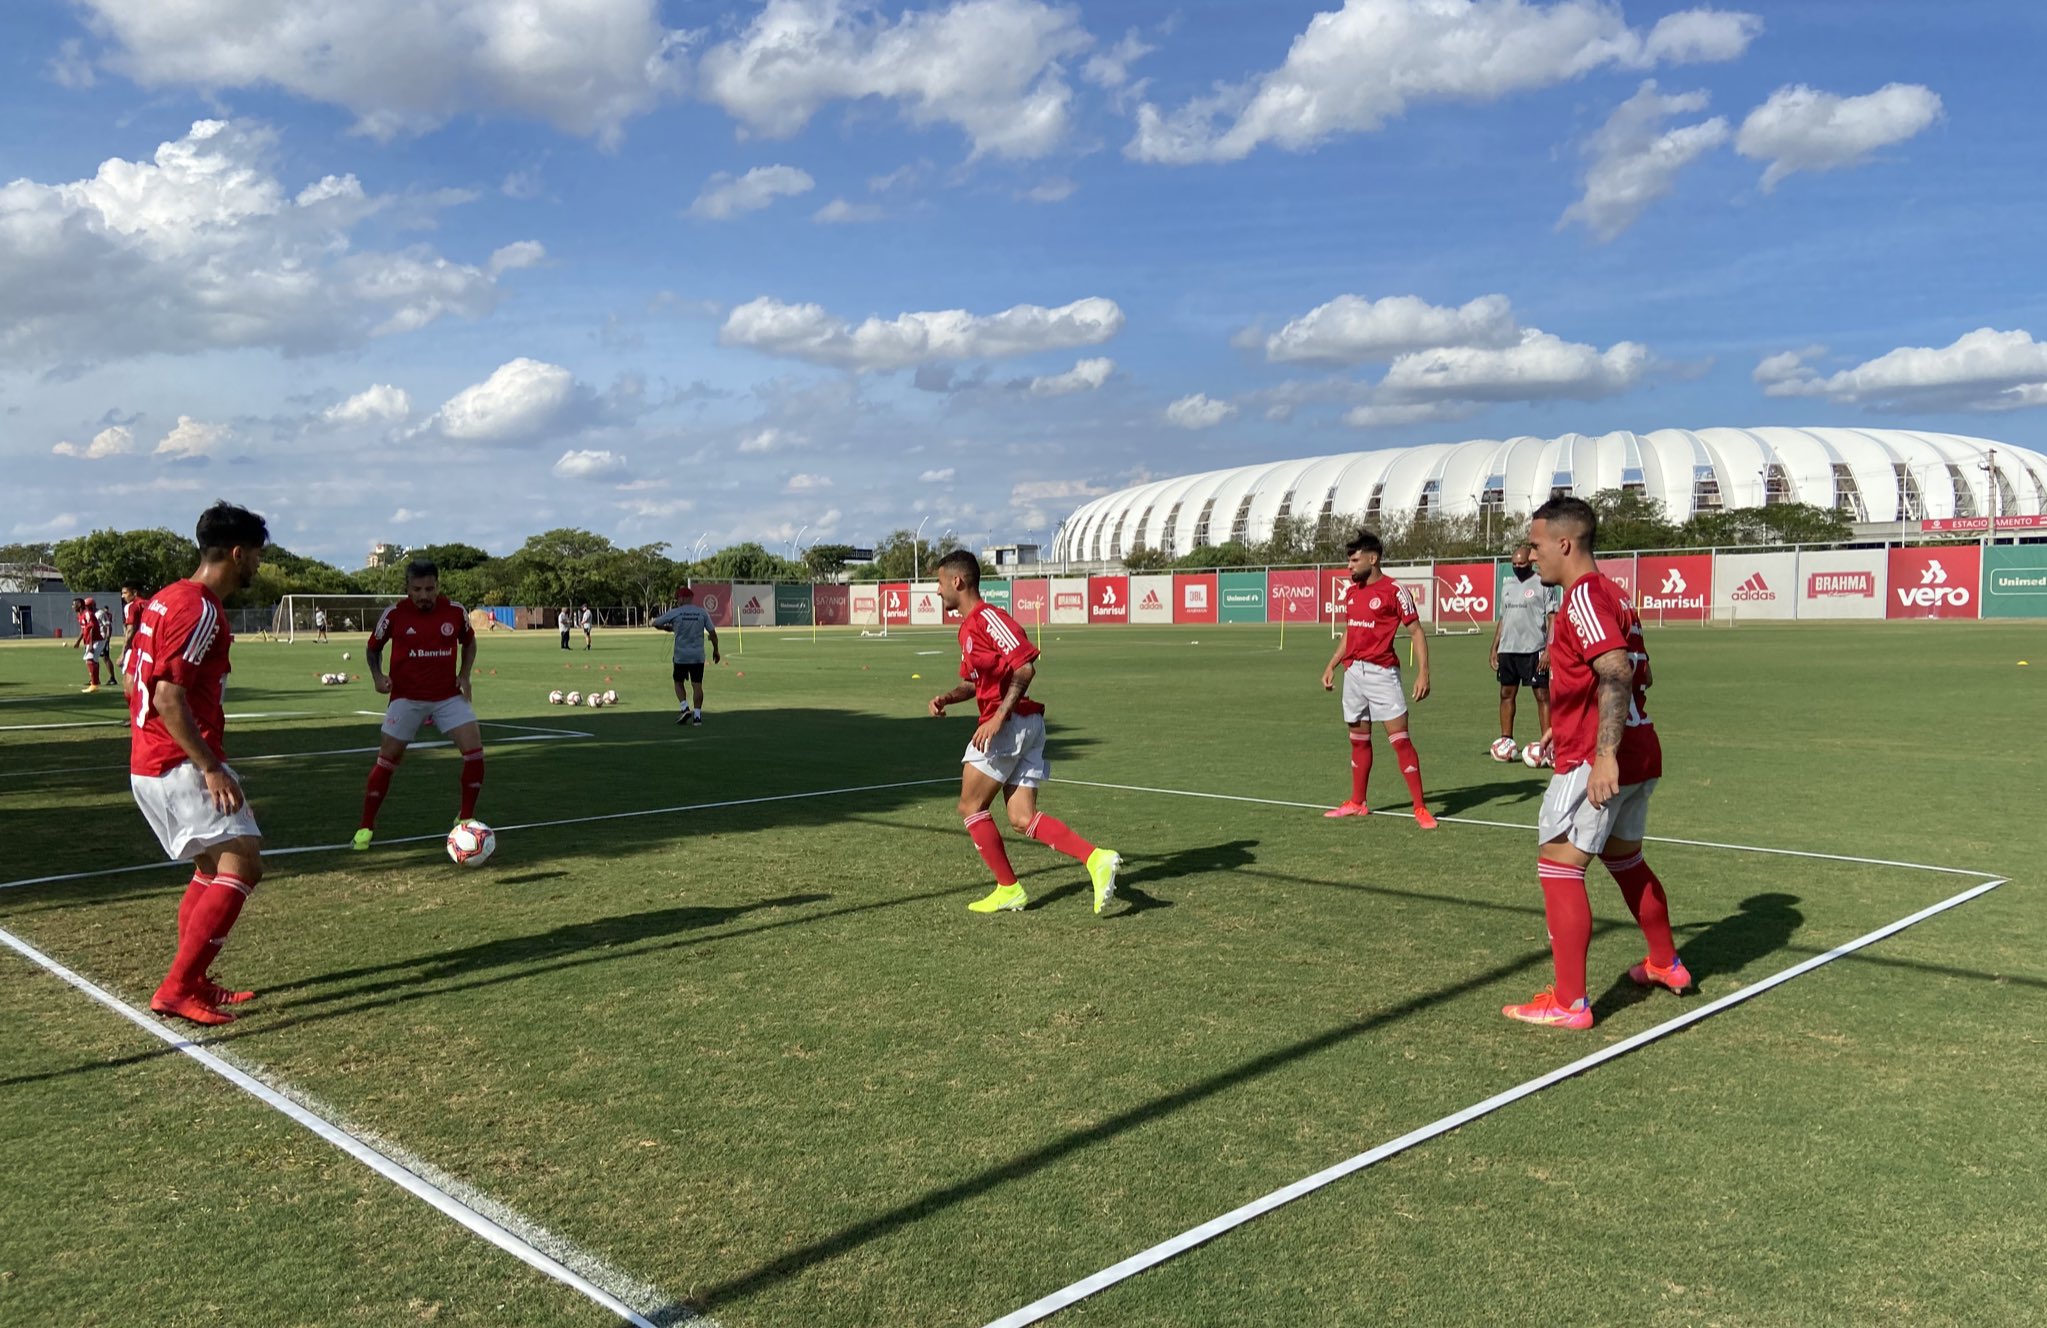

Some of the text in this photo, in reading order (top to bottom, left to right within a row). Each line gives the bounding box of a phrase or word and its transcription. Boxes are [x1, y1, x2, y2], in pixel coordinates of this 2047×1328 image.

[1952, 517, 2033, 529] ESTACIOAMENTO
[1815, 575, 1867, 591] BRAHMA
[1998, 576, 2047, 587] Unimed
[1272, 586, 1314, 599] SARANDI
[1731, 589, 1776, 601] adidas
[1897, 587, 1970, 607] vero
[1139, 602, 1163, 610] adidas
[1440, 596, 1488, 613] vero
[1643, 593, 1704, 609] Banrisul
[1092, 604, 1126, 616] Banrisul
[1567, 602, 1585, 638] vero
[986, 624, 1006, 649] vero
[418, 647, 452, 657] Banrisul
